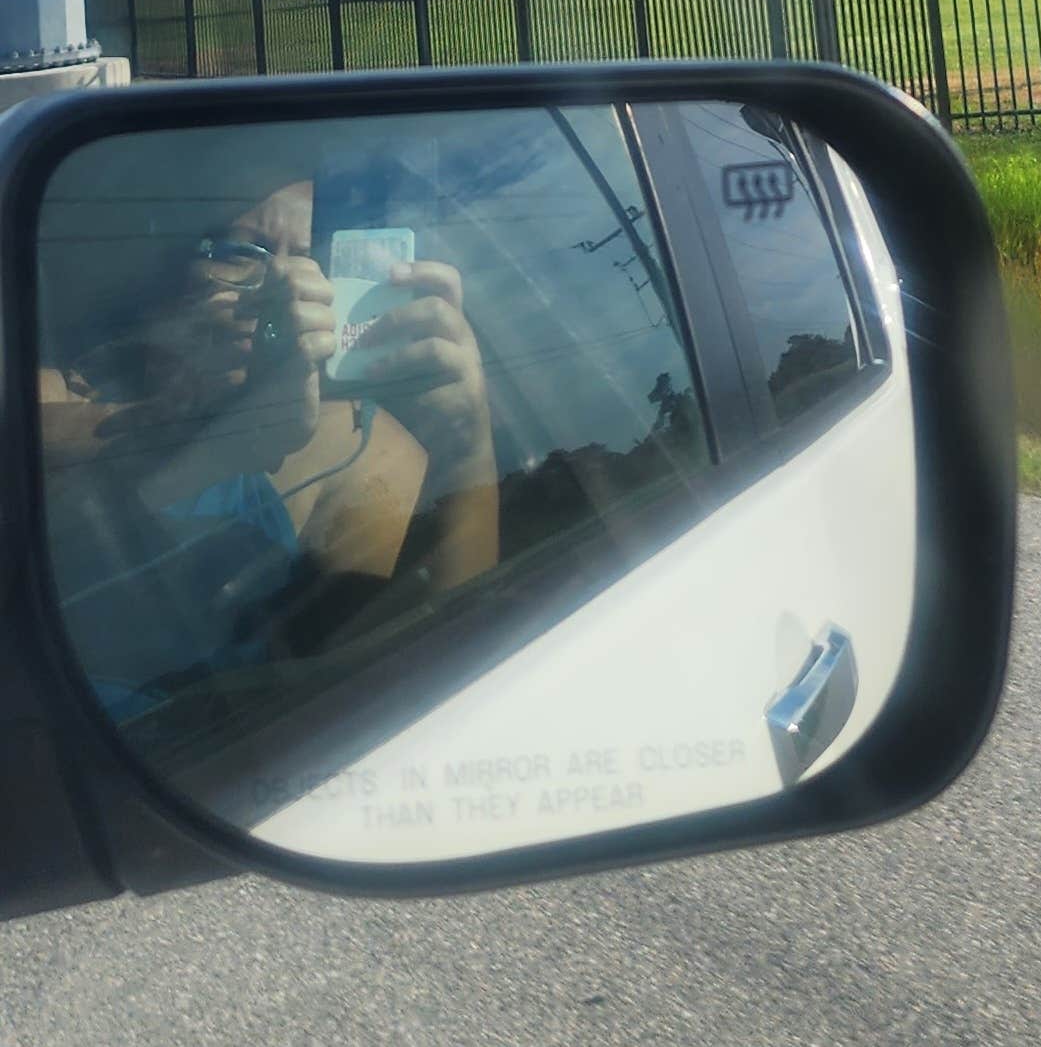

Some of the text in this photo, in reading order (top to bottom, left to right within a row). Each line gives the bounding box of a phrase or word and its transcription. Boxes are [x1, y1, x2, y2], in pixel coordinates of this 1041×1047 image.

[402, 763, 426, 789] IN
[444, 753, 551, 787] MIRROR
[567, 748, 619, 776] ARE
[639, 739, 747, 772] CLOSER
[360, 783, 645, 828] THAN THEY APPEAR
